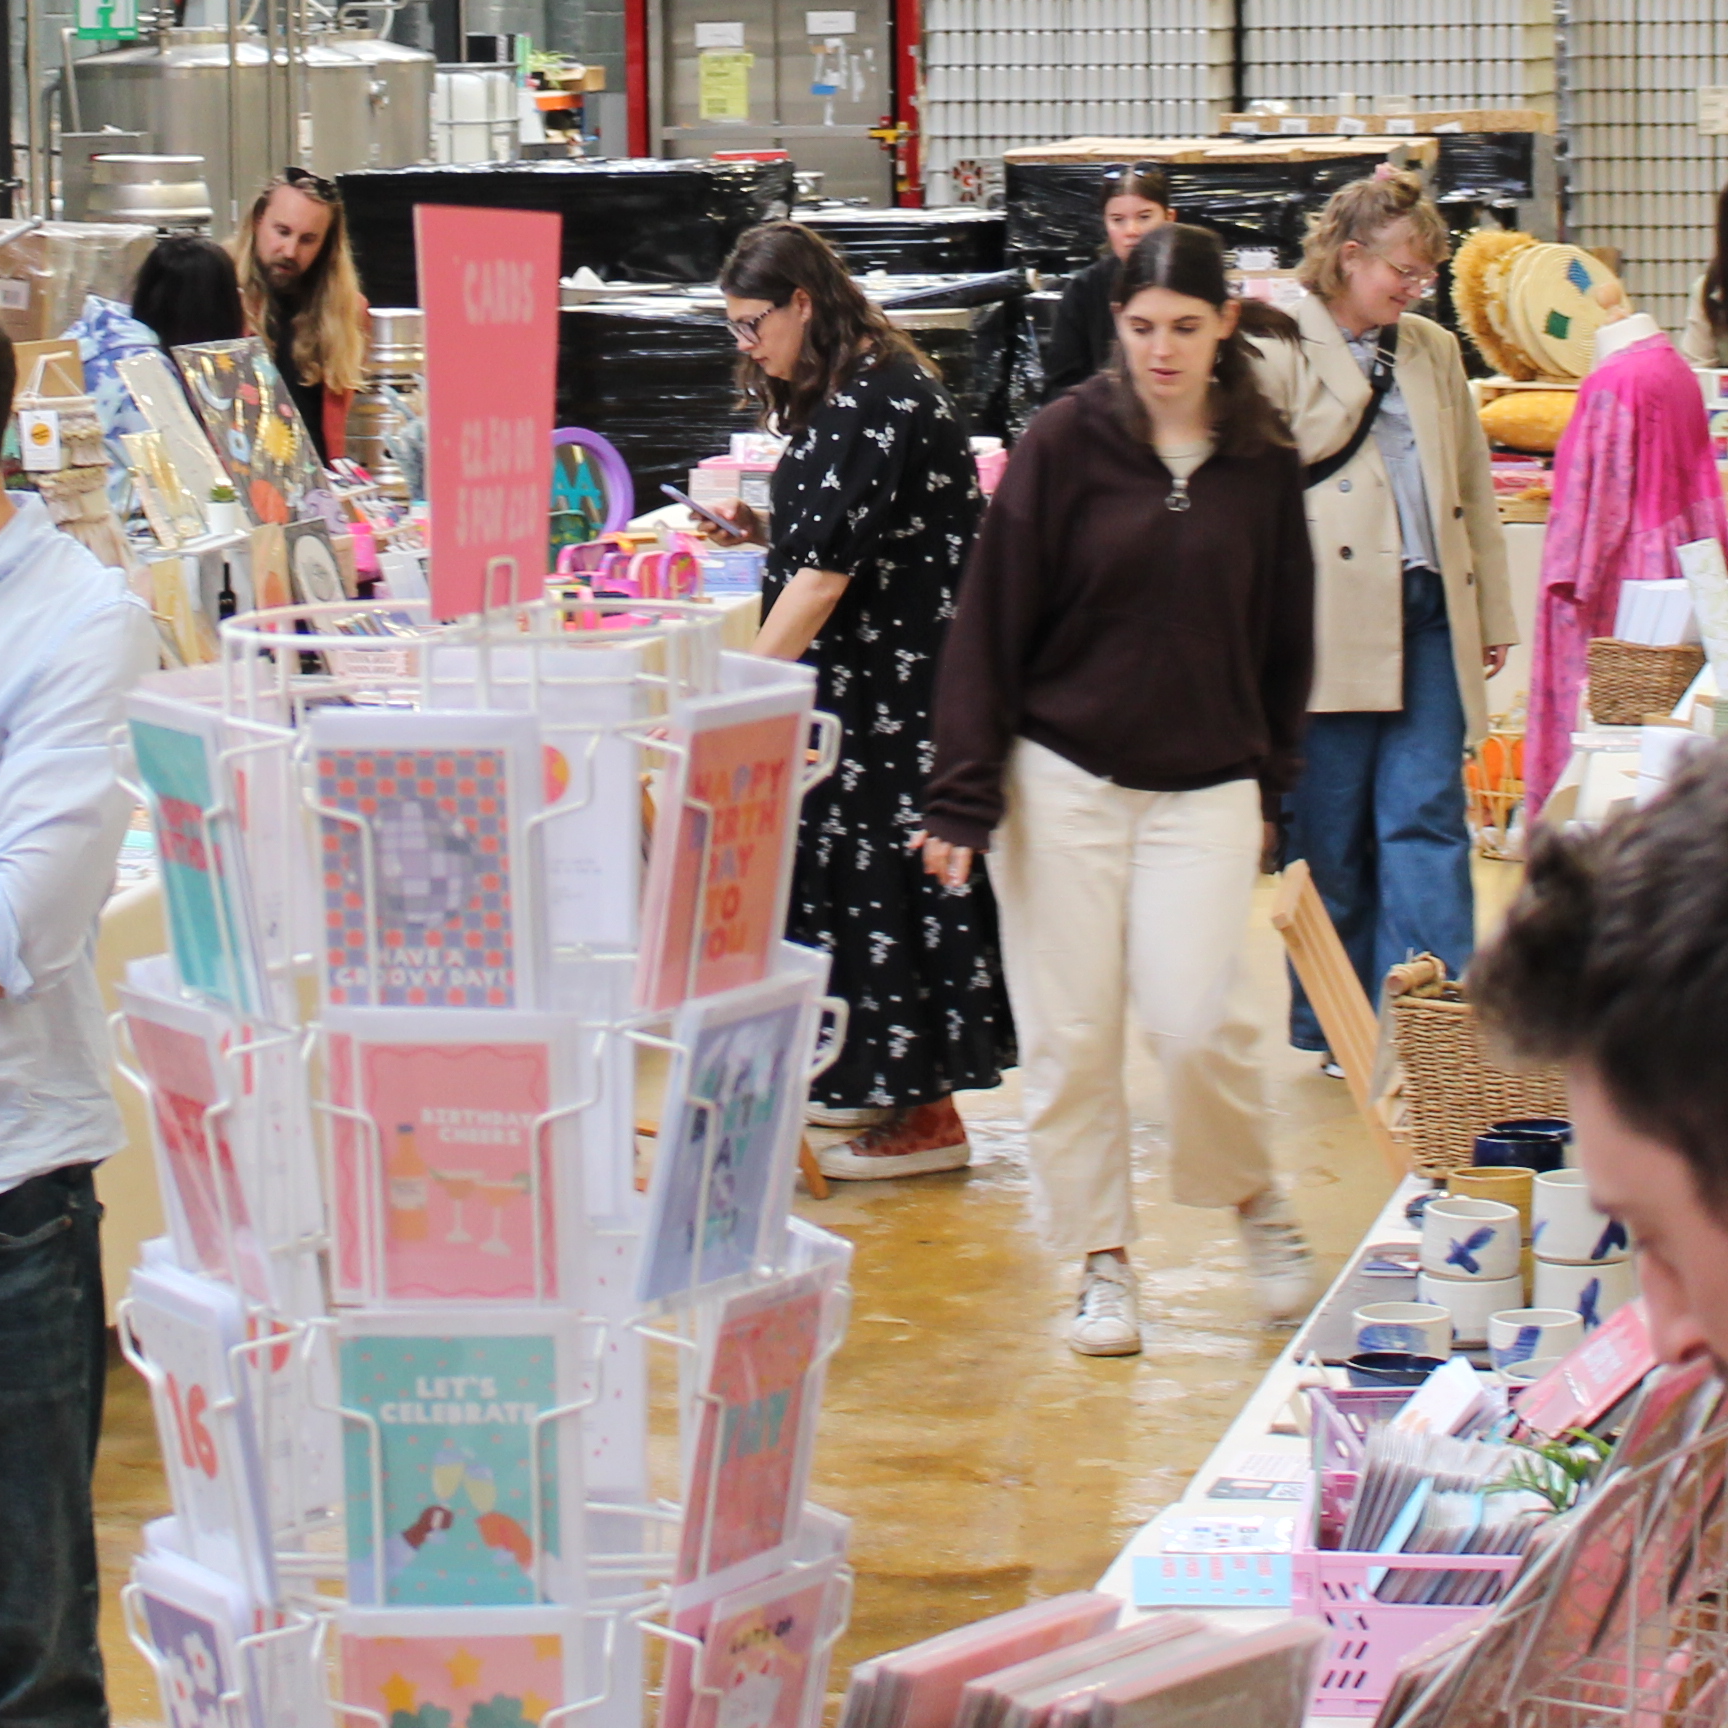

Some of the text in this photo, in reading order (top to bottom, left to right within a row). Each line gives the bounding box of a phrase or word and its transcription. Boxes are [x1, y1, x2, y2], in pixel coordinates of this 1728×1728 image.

[462, 257, 535, 325] CARDS
[334, 966, 446, 987] GROVY
[437, 1126, 521, 1146] CHEERS
[415, 1376, 497, 1401] LET'S
[379, 1401, 539, 1426] CELEBRATE
